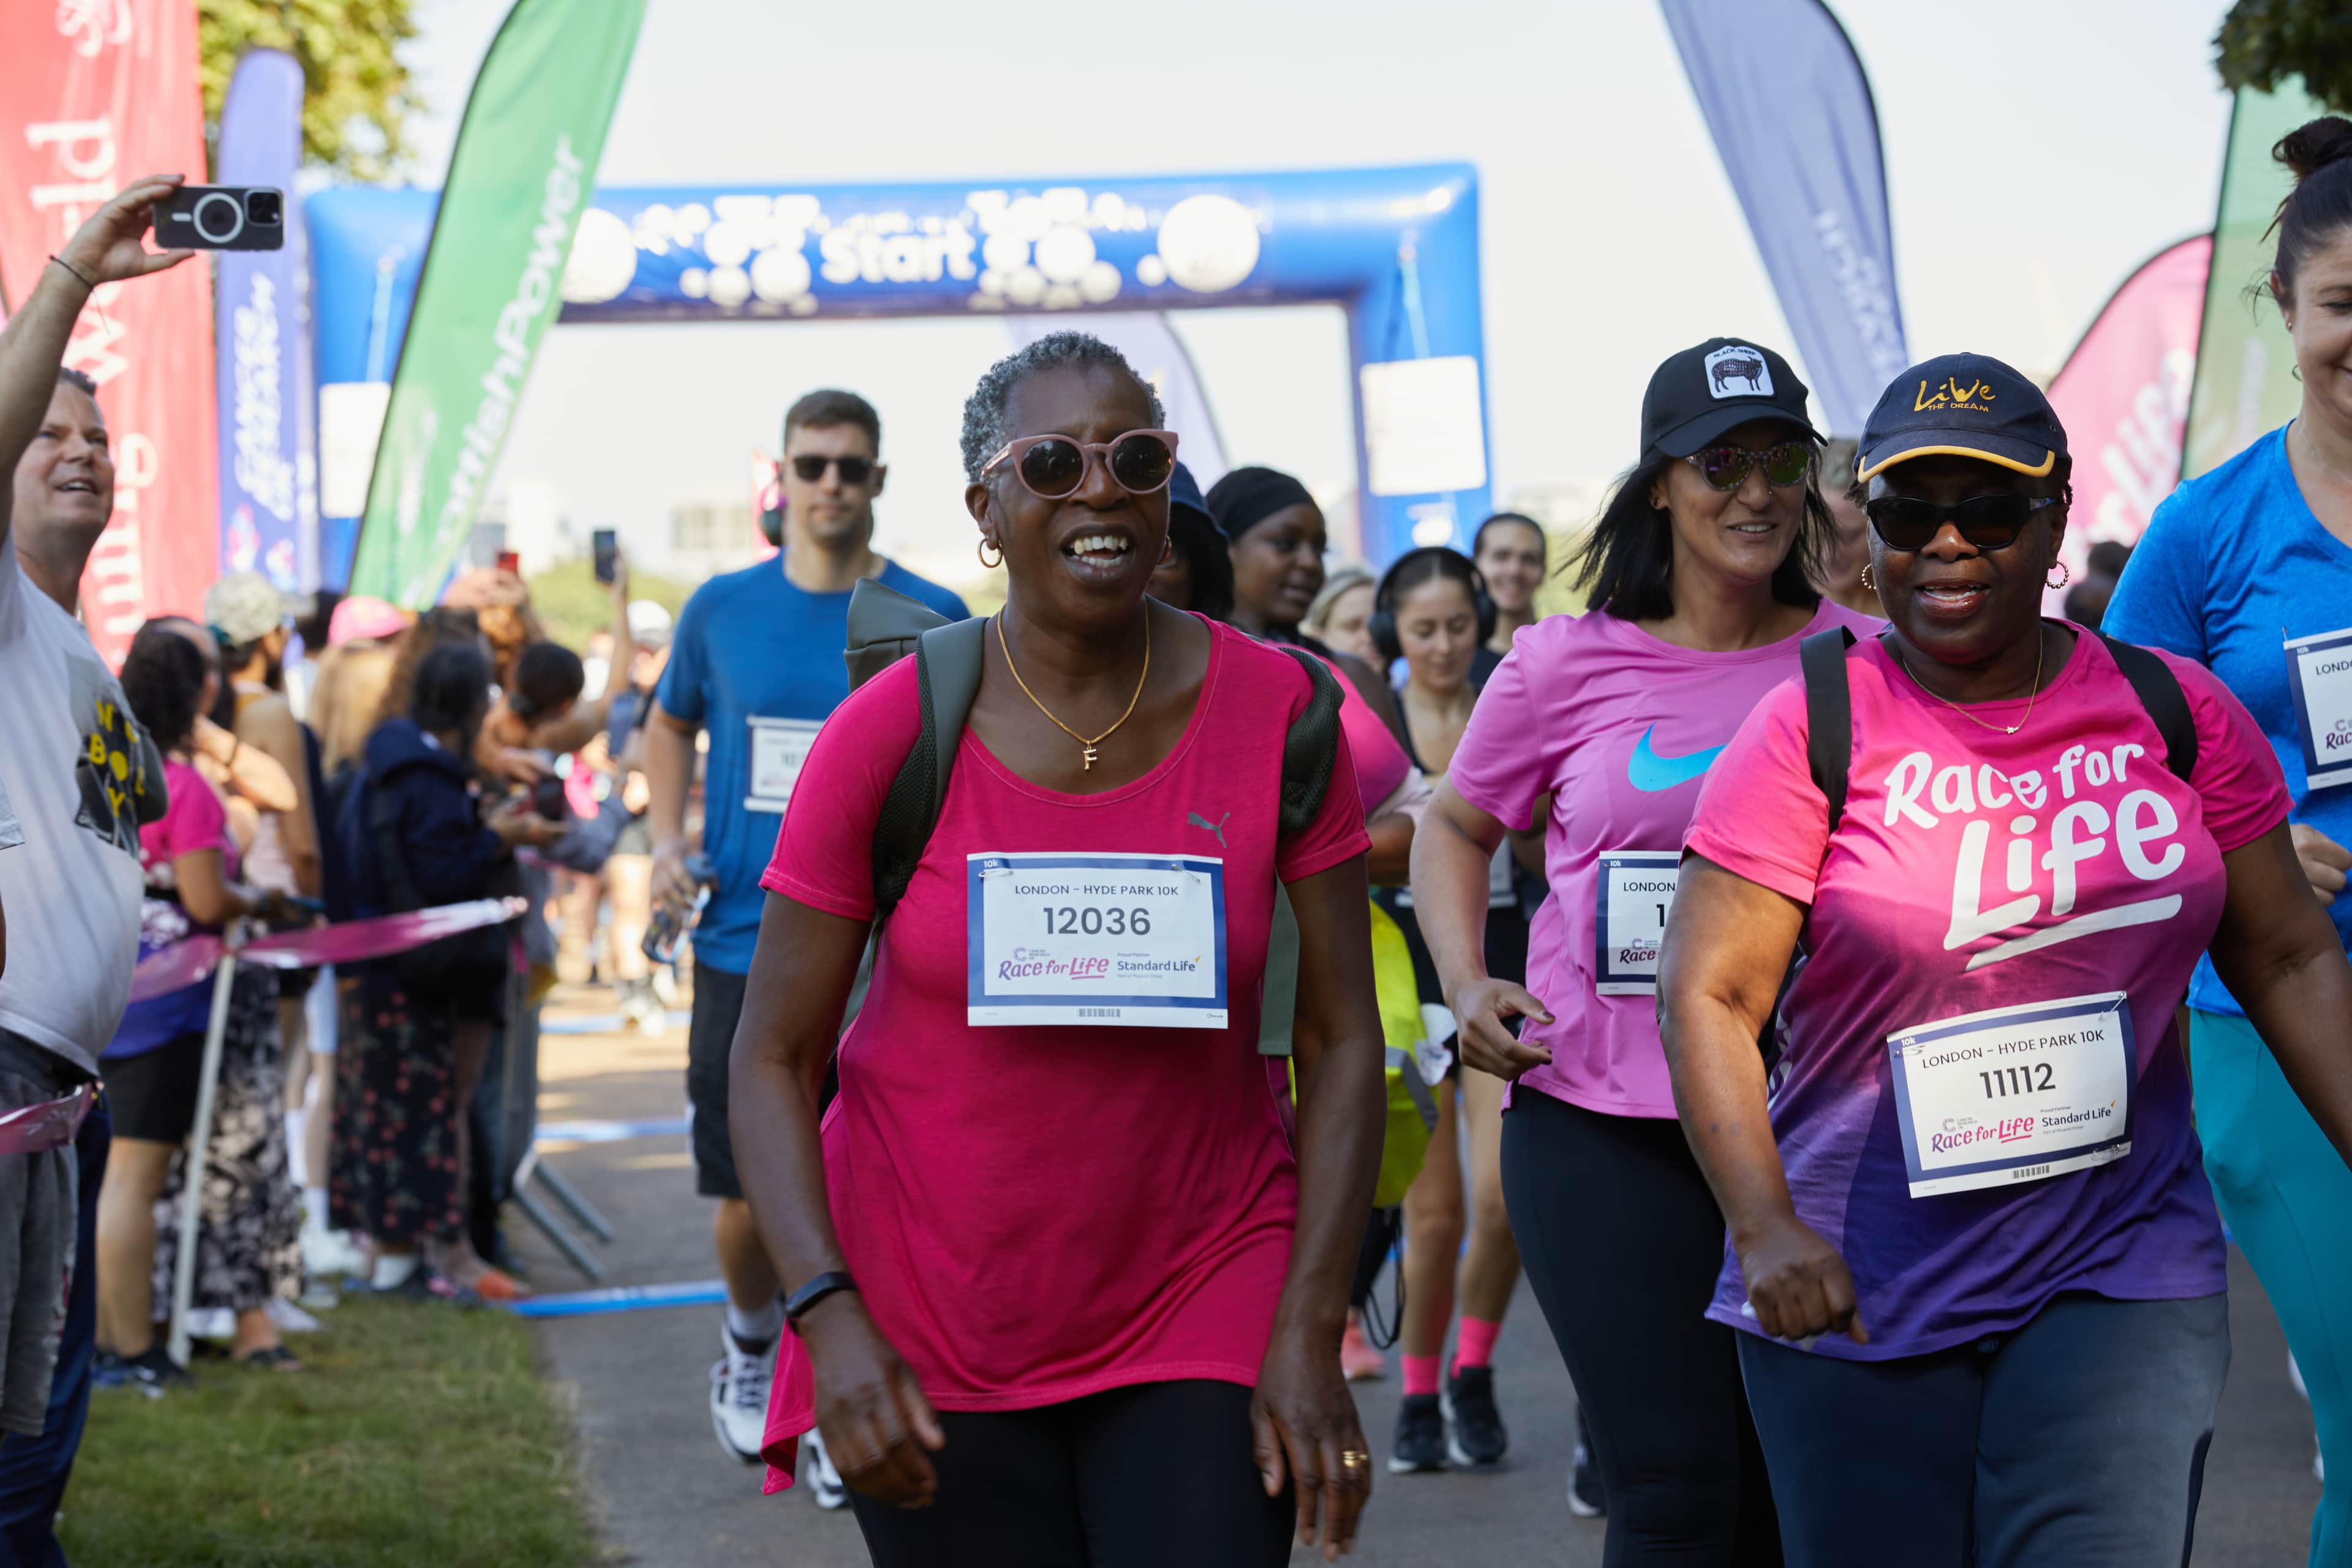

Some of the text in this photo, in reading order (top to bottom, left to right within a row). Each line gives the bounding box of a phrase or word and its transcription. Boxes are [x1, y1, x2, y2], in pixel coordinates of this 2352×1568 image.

[820, 217, 977, 285] Start
[1713, 348, 1736, 358] BLACK
[1928, 402, 1989, 412] THE DREAM
[2315, 660, 2352, 676] LOND
[2326, 732, 2352, 750] Rac
[1082, 748, 1098, 770] F
[1883, 744, 2144, 829] Race for
[983, 859, 999, 869] 10k
[1943, 788, 2186, 951] Life
[1015, 885, 1069, 894] LONDON
[1084, 885, 1117, 895] HYDE
[1121, 886, 1154, 895] PARK
[1157, 886, 1179, 895] 10K
[1623, 881, 1676, 892] LONDON
[1043, 907, 1151, 936] 12036
[1117, 960, 1196, 971] Standard Life
[1619, 949, 1656, 964] Race
[998, 957, 1109, 981] Race for Life
[1901, 1036, 1916, 1047] 10k
[1922, 1047, 1983, 1069] LONDON
[1998, 1039, 2036, 1055] HYDE
[2039, 1033, 2077, 1049] PARK
[2080, 1029, 2105, 1043] 10K
[1979, 1063, 2056, 1099] 11112
[2041, 1107, 2112, 1127] Standard Life
[1931, 1117, 2035, 1153] Race for Life
